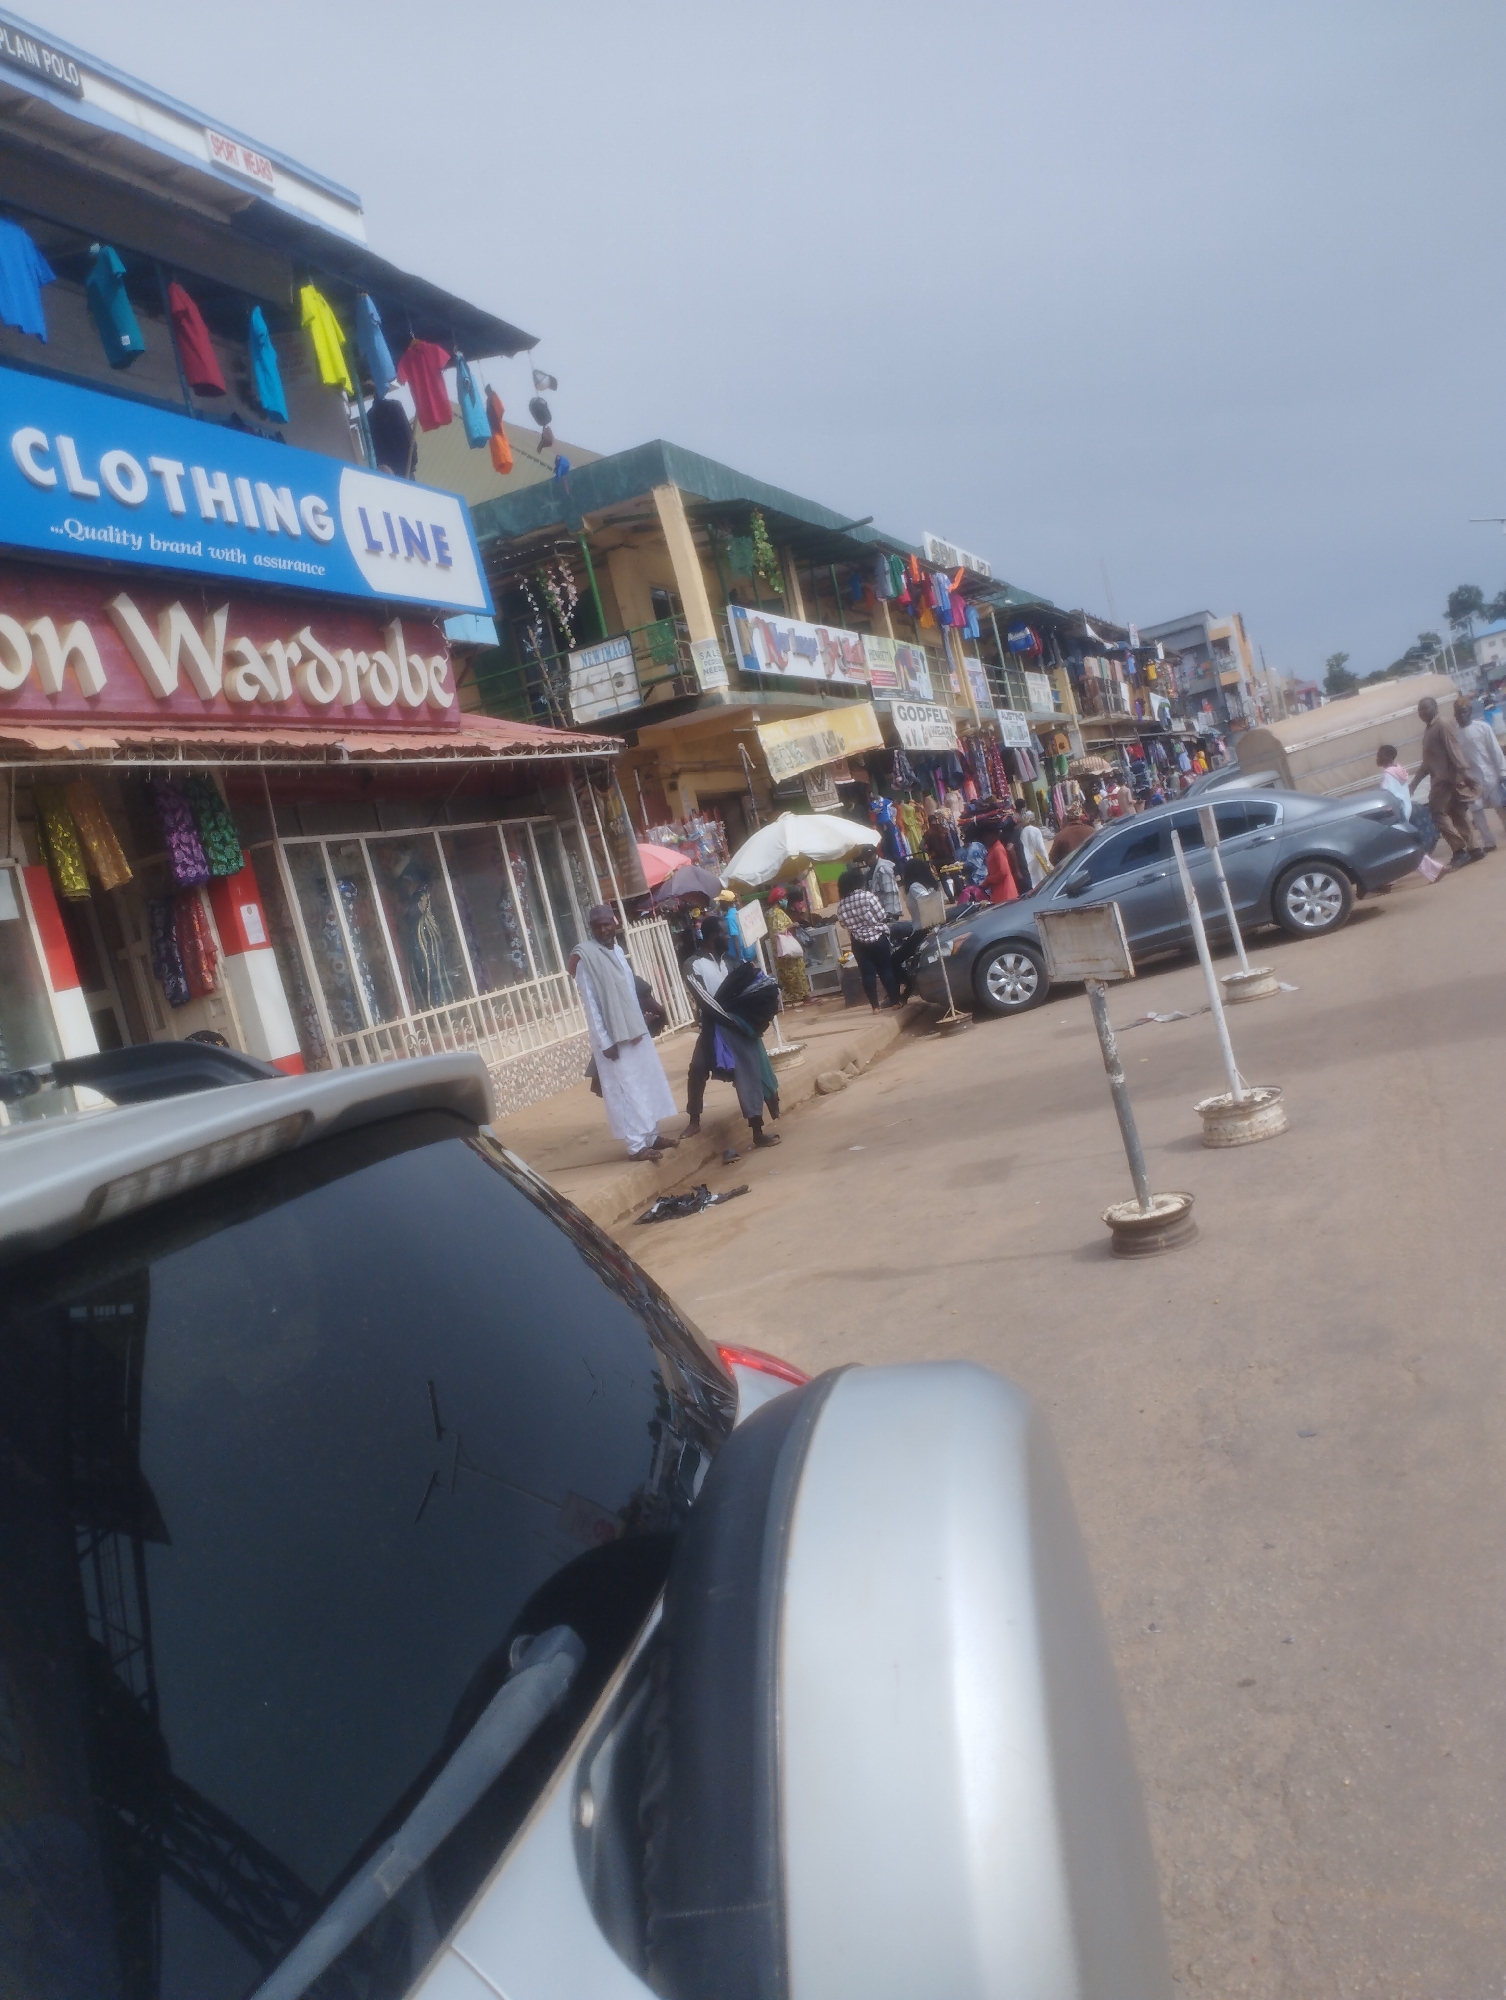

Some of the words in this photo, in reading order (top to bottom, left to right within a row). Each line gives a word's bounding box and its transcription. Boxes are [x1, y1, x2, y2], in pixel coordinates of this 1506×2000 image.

[41, 48, 79, 87] POLO
[210, 133, 240, 166] SPORT
[241, 148, 274, 183] WEARS
[11, 427, 335, 542] CLOTHING
[357, 506, 453, 569] LINE
[149, 532, 203, 558] brand
[207, 545, 247, 566] with
[252, 553, 326, 577] assurance
[104, 592, 455, 709] Wardrobe
